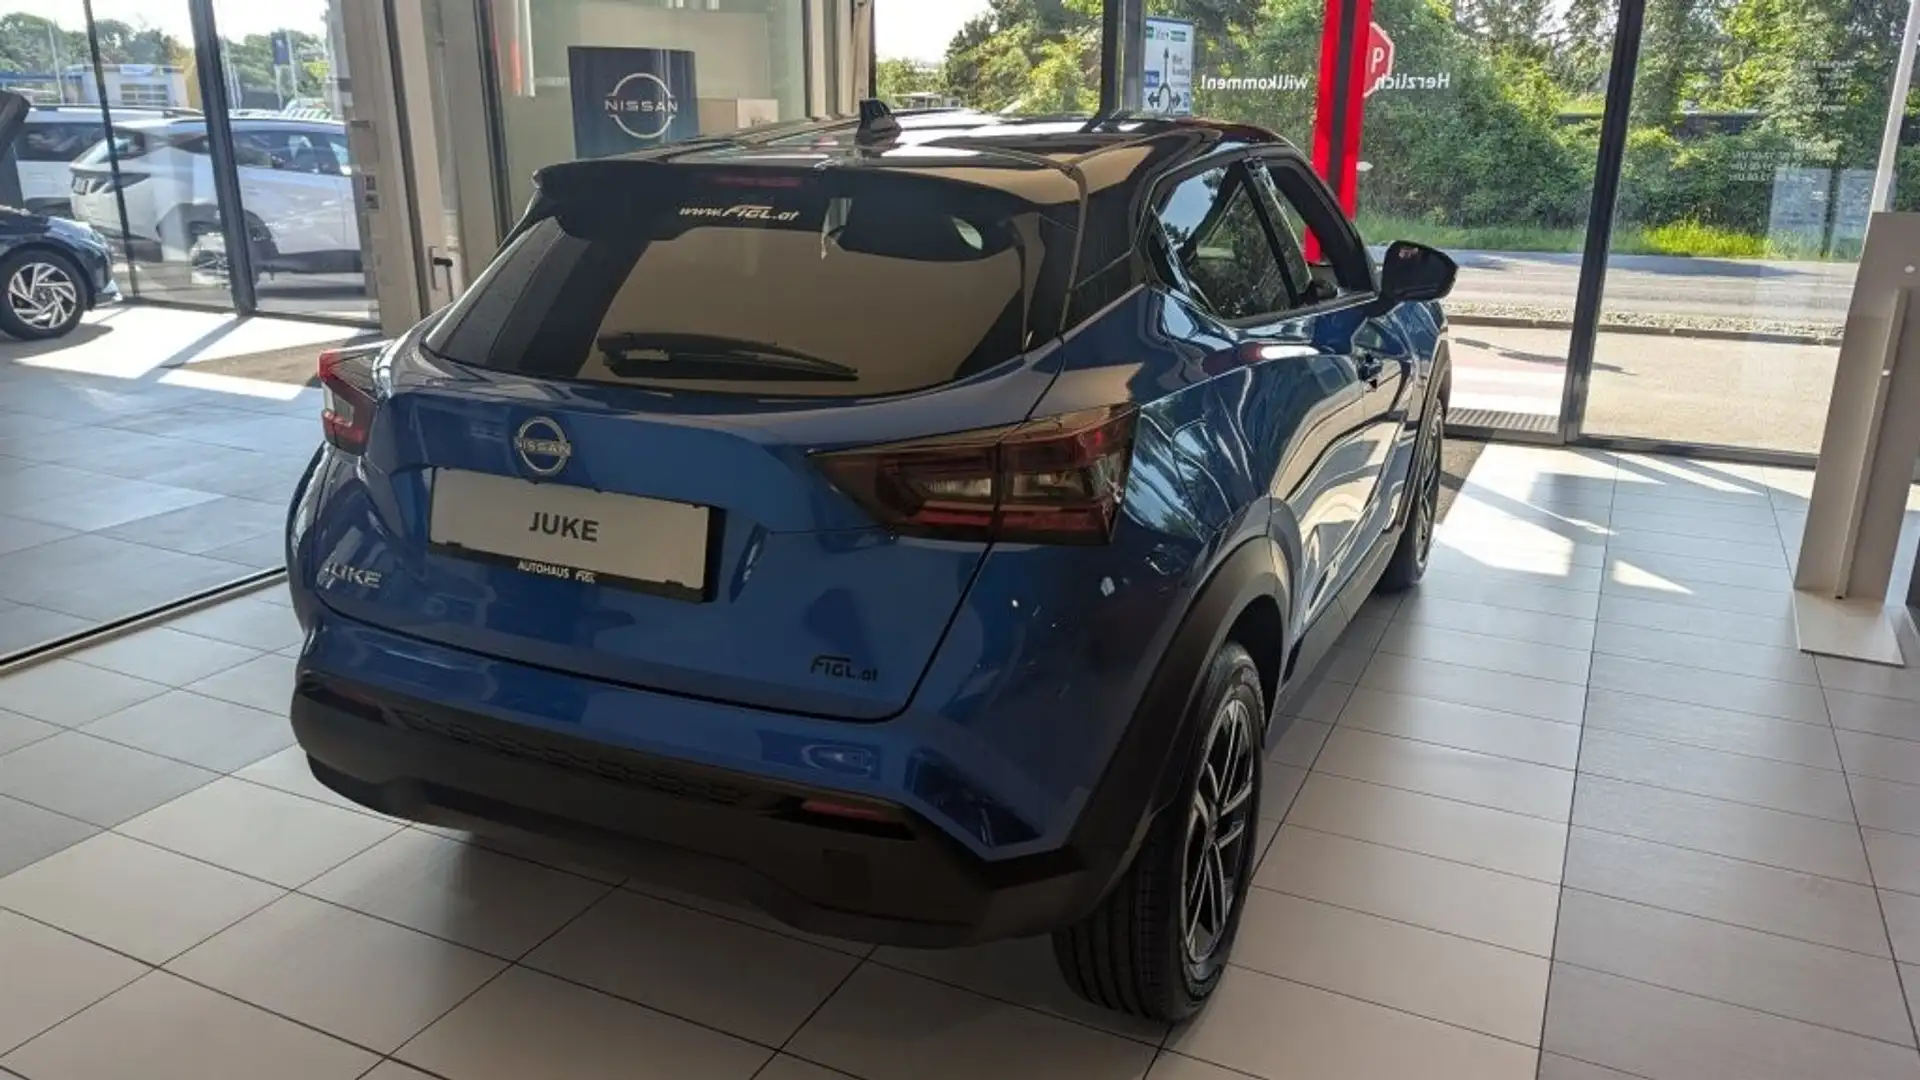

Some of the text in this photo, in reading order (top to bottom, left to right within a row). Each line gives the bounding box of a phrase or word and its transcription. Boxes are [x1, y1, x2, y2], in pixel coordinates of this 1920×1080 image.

[604, 99, 678, 113] NISSAN
[514, 435, 571, 456] NISSAN
[528, 511, 600, 543] JUKE
[321, 562, 382, 590] JUKE
[517, 560, 569, 579] AUTOHAUS
